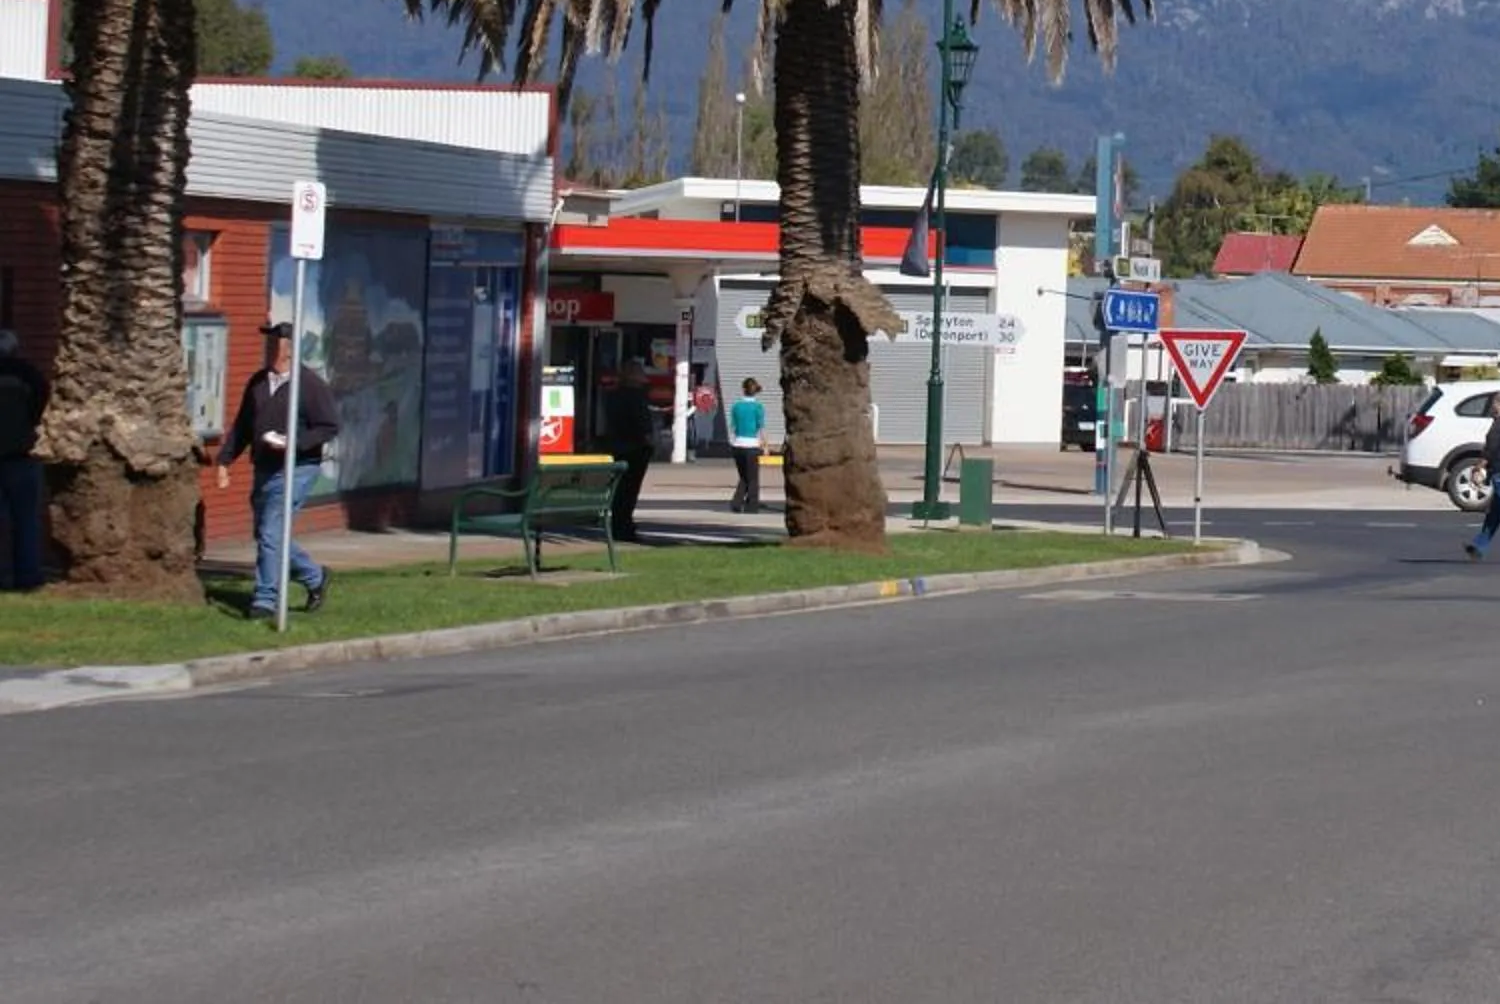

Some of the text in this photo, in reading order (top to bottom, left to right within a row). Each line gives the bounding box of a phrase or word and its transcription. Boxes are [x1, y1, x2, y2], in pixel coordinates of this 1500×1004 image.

[547, 298, 580, 320] op
[915, 315, 1015, 328] Spyton 24
[914, 328, 989, 342] (Deonport)
[1184, 343, 1221, 357] GIVE
[1190, 359, 1214, 369] WAY
